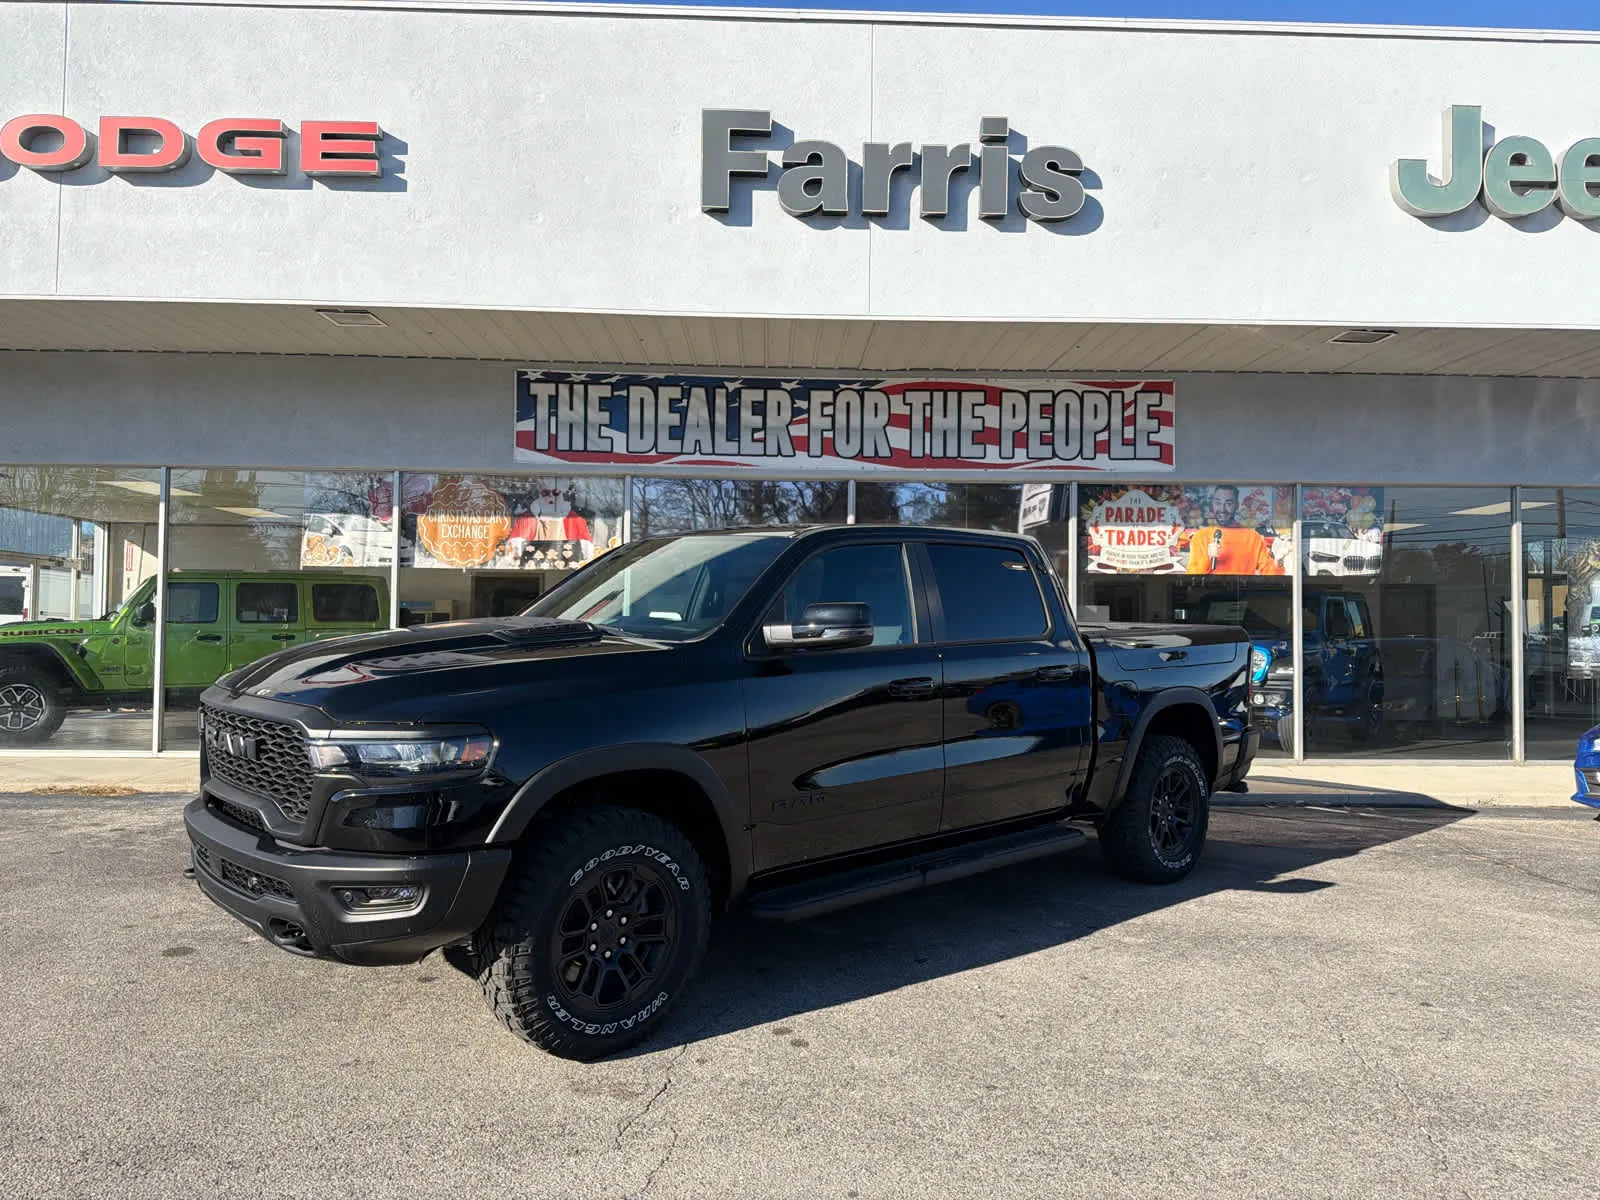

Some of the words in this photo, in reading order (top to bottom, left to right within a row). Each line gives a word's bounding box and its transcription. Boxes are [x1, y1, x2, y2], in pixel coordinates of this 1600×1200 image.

[0, 114, 383, 176] ODGE
[701, 108, 1086, 220] Farris
[527, 380, 614, 453] THE
[626, 384, 796, 458] DEALER
[807, 389, 892, 459] FOR
[904, 388, 987, 460] THE
[999, 389, 1163, 461] PEOPLE
[428, 509, 480, 523] CHRISTMAS
[483, 509, 502, 523] CAR
[441, 524, 489, 539] EXCHANGE
[1105, 506, 1167, 523] PARADE
[1104, 529, 1167, 546] TRADES
[569, 844, 690, 890] GOODYEAR
[547, 992, 668, 1035] WRANGLER
